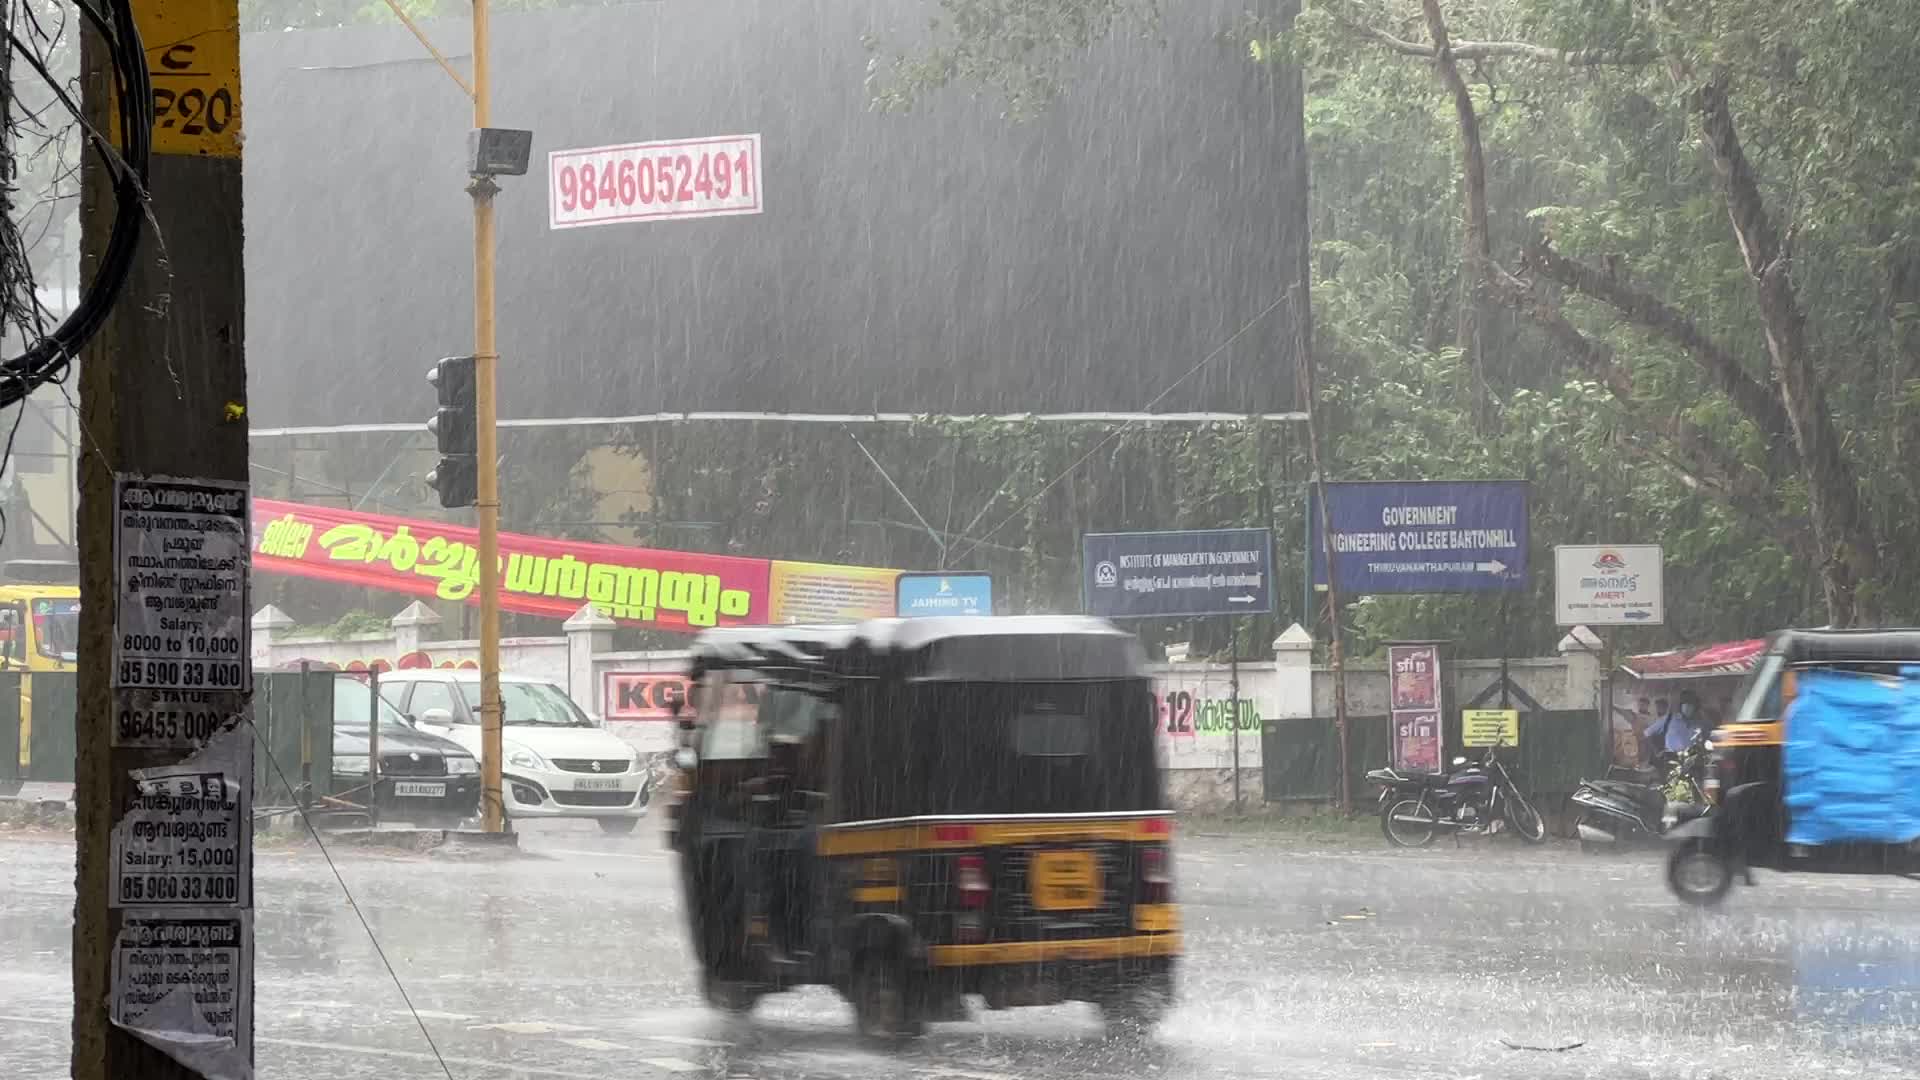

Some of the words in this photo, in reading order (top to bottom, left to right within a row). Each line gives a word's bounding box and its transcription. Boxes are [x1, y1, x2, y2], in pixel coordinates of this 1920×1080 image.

[559, 149, 749, 213] 9846052491
[1382, 506, 1457, 526] GOVERNMENT
[1398, 531, 1448, 551] COLLEGE
[1450, 529, 1517, 550] BARTONHILL
[1119, 554, 1153, 568] INSTITUTE
[1153, 554, 1161, 567] OF
[1162, 552, 1208, 567] MANAGEMENT
[1216, 550, 1260, 565] GOVERNMENT
[123, 635, 161, 651] 8000
[166, 637, 182, 652] to
[188, 636, 239, 656] 10,000
[120, 661, 142, 685] 85
[146, 662, 178, 686] 900
[183, 663, 205, 687] 33
[208, 664, 241, 688] 400
[152, 690, 210, 703] STATUE
[120, 711, 177, 739] 96455
[133, 818, 231, 842] ആവശ്യമുണ്ട്
[125, 851, 173, 869] Salary:
[177, 848, 234, 868] 15,000
[123, 876, 144, 899] 85
[147, 876, 178, 899] 900
[181, 877, 200, 899] 33
[205, 877, 235, 899] 400
